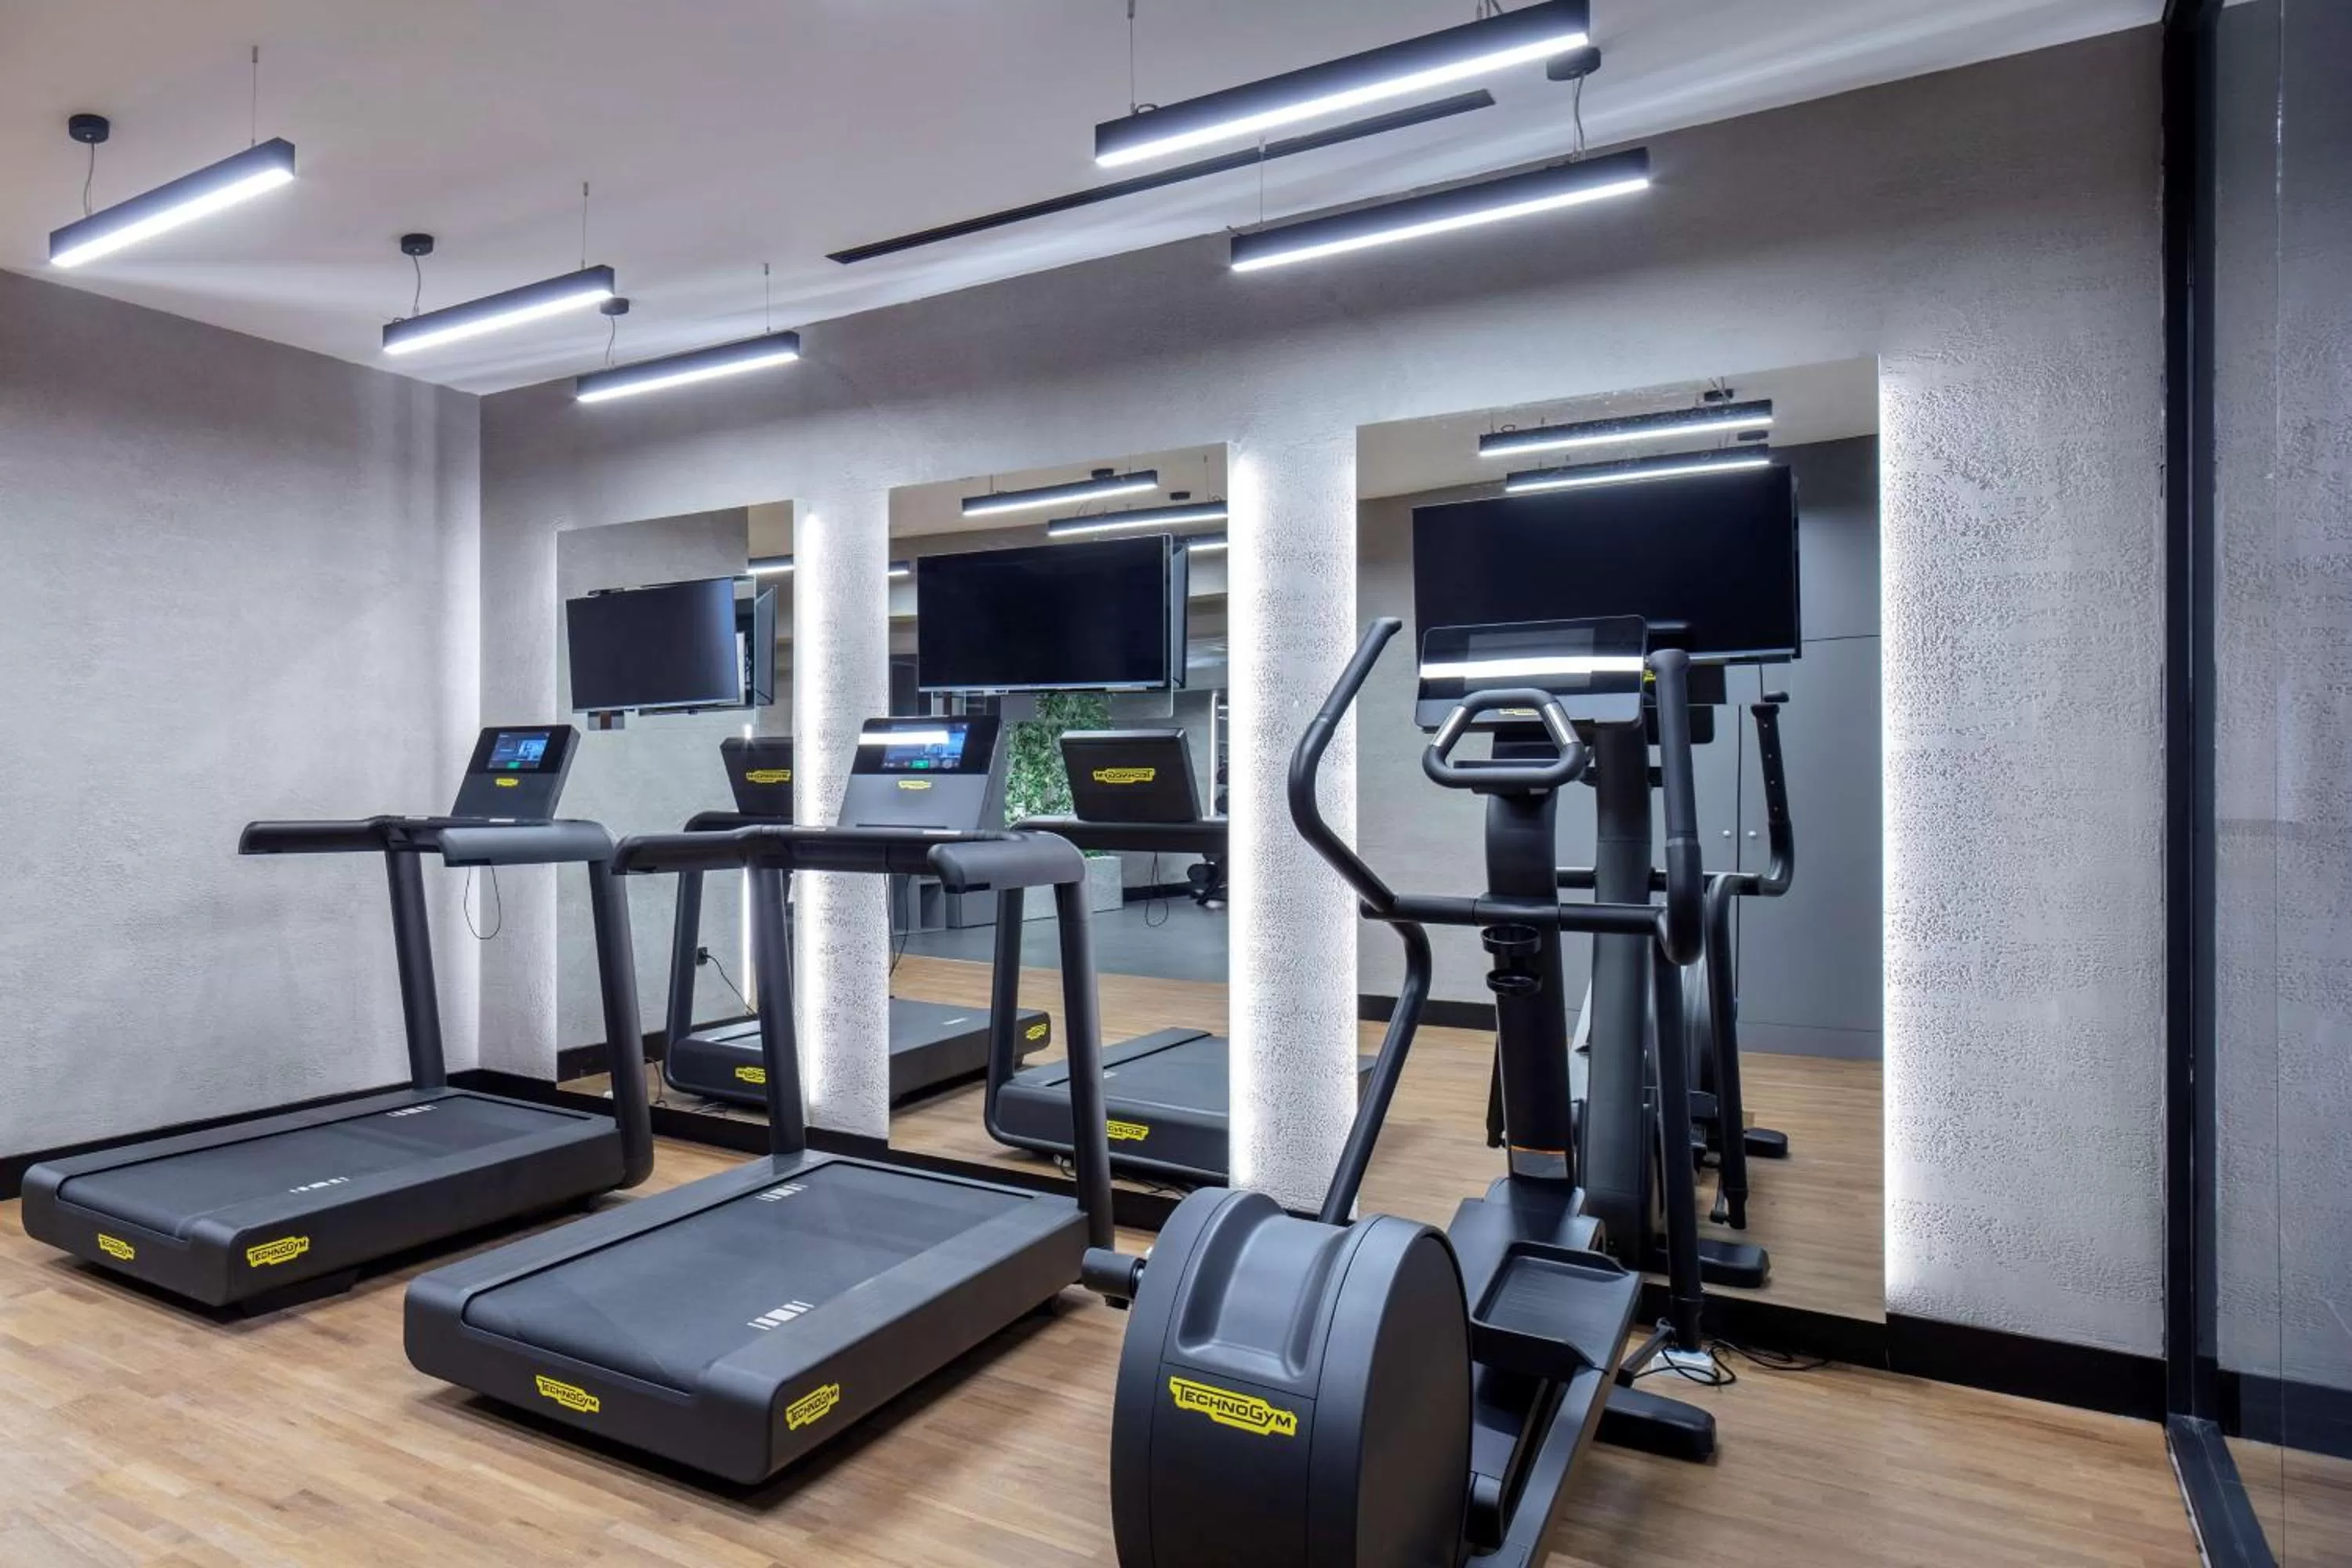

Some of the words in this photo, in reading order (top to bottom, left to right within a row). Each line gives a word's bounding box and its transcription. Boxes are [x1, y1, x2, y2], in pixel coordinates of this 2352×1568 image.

[249, 1238, 307, 1264] TECHNOGYM
[537, 1377, 598, 1408] TECHNOGYM
[1172, 1380, 1292, 1429] TECHNOGYM
